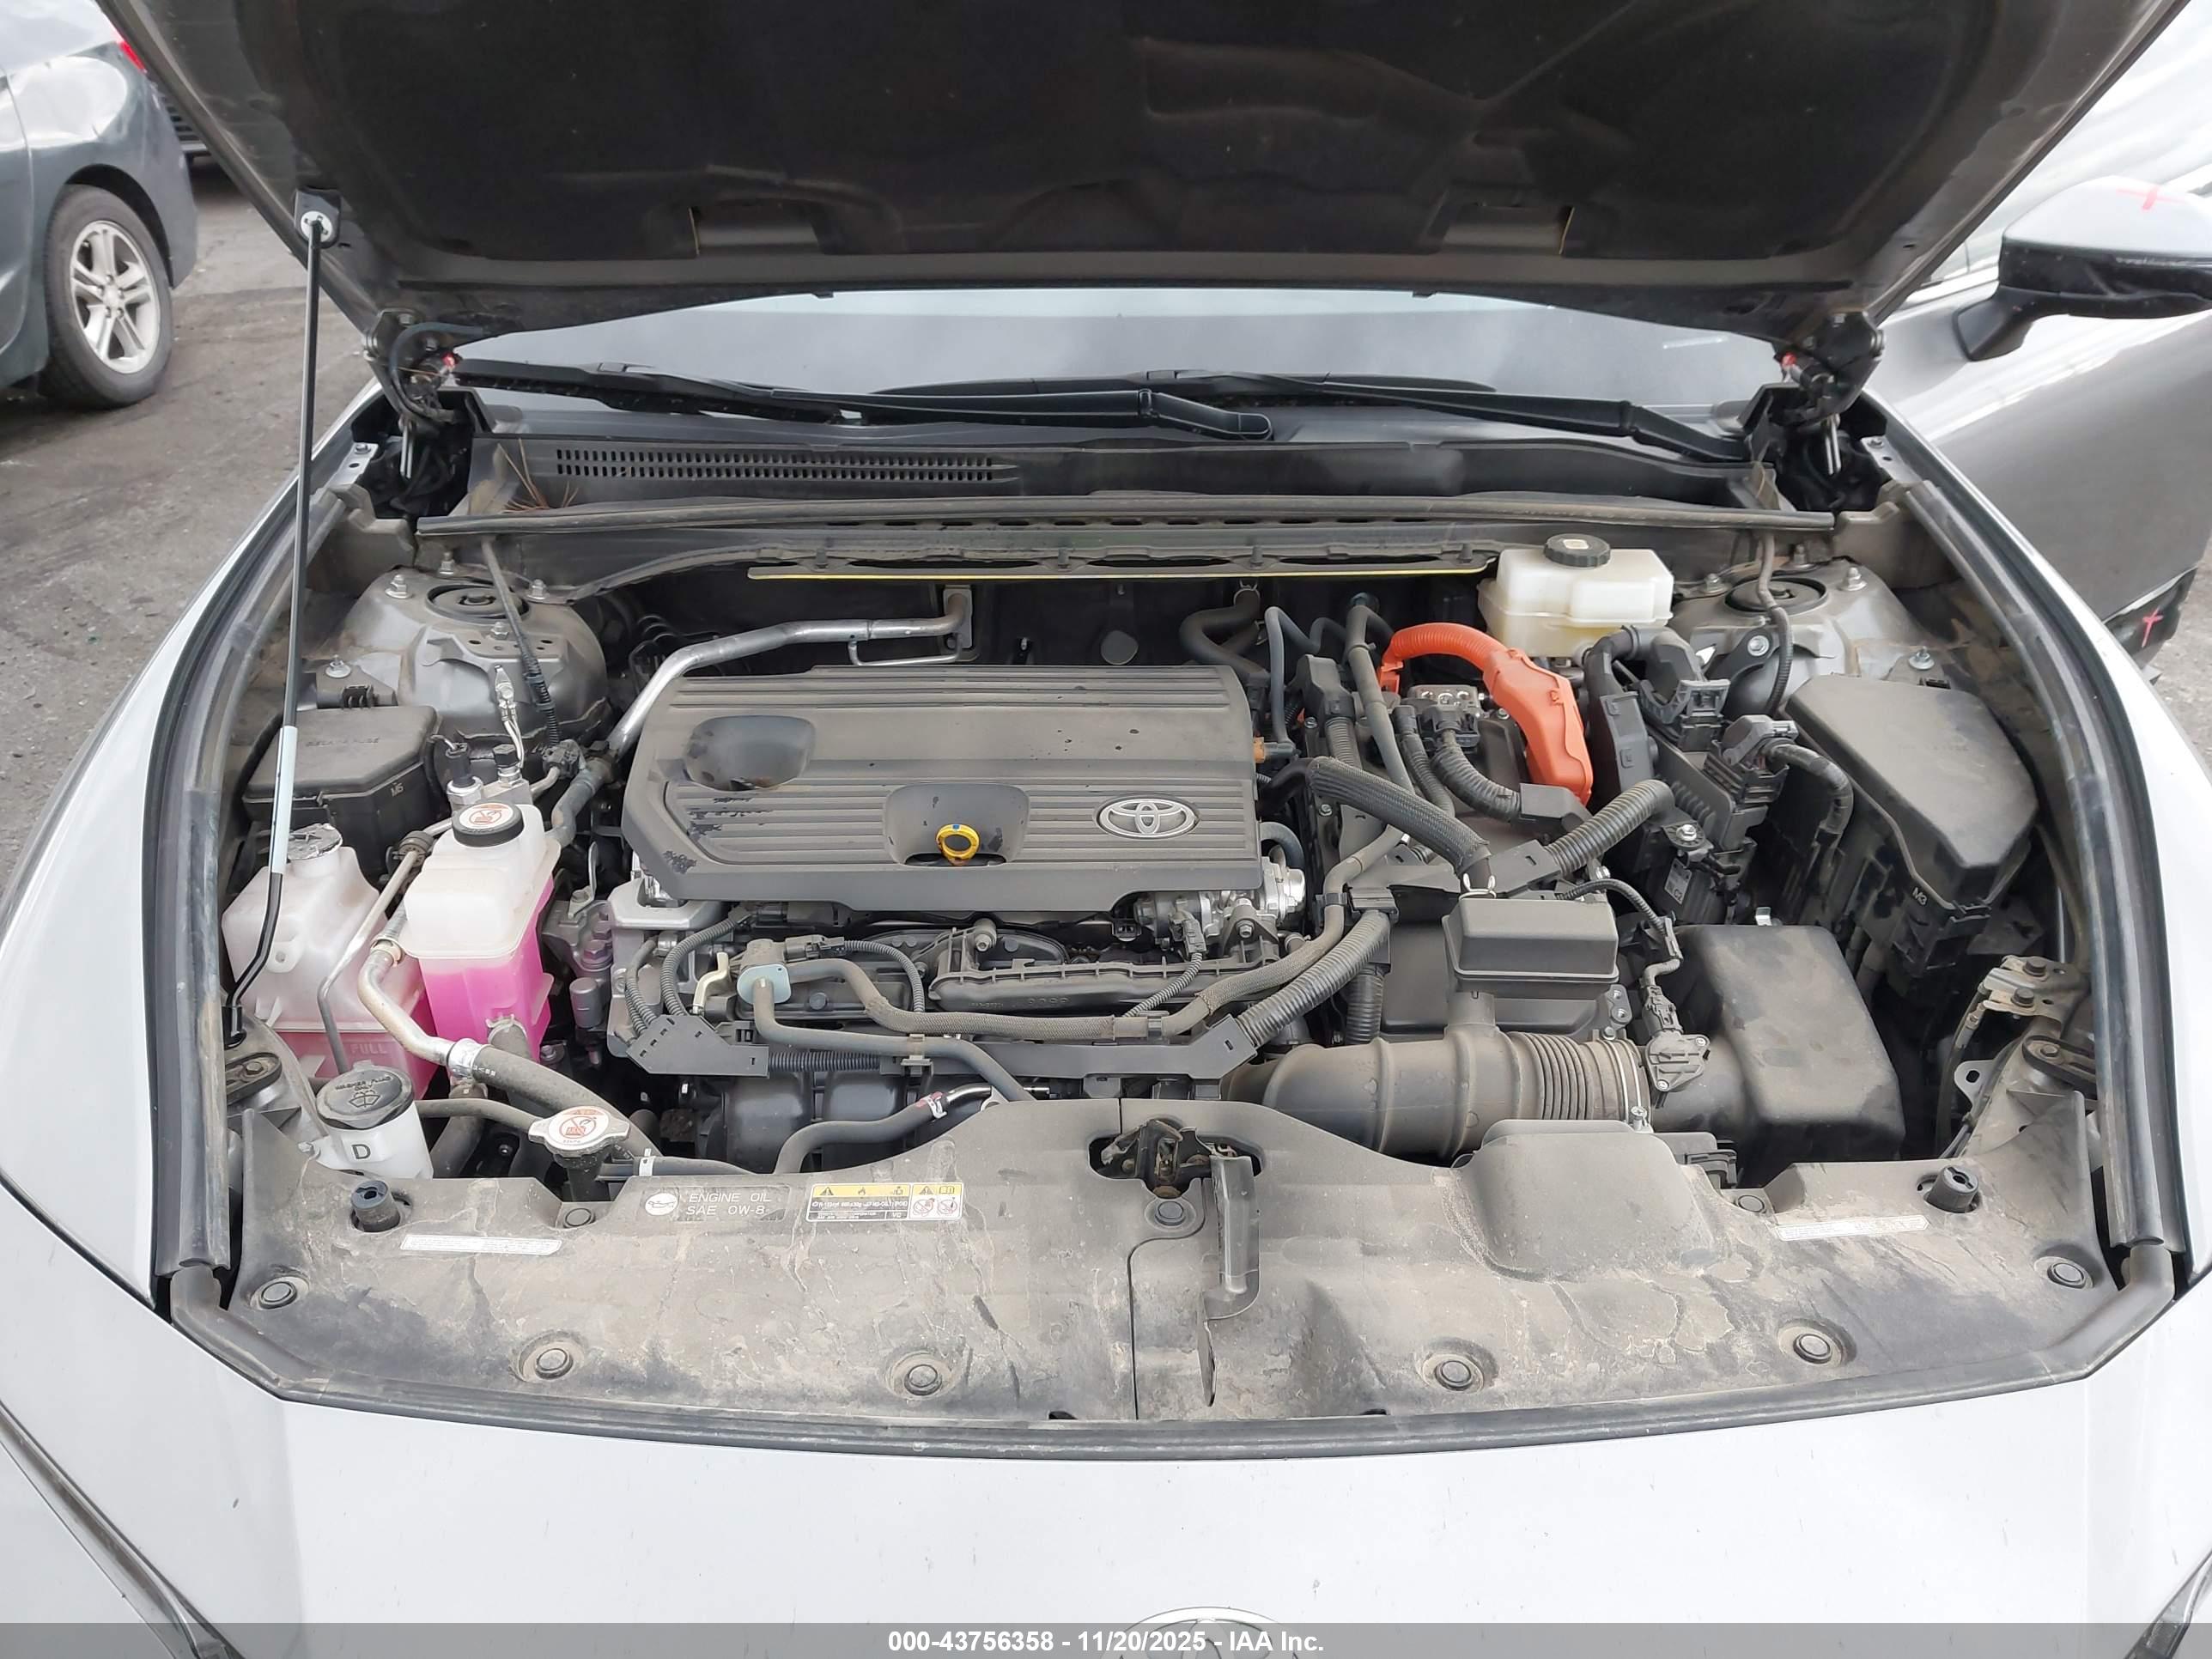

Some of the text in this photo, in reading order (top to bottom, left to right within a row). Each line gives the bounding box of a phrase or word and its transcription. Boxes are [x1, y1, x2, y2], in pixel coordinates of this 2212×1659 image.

[350, 1043, 388, 1054] FULL
[351, 1144, 371, 1159] D
[689, 1193, 772, 1203] ENGINE OIL
[686, 1205, 717, 1215] SAE
